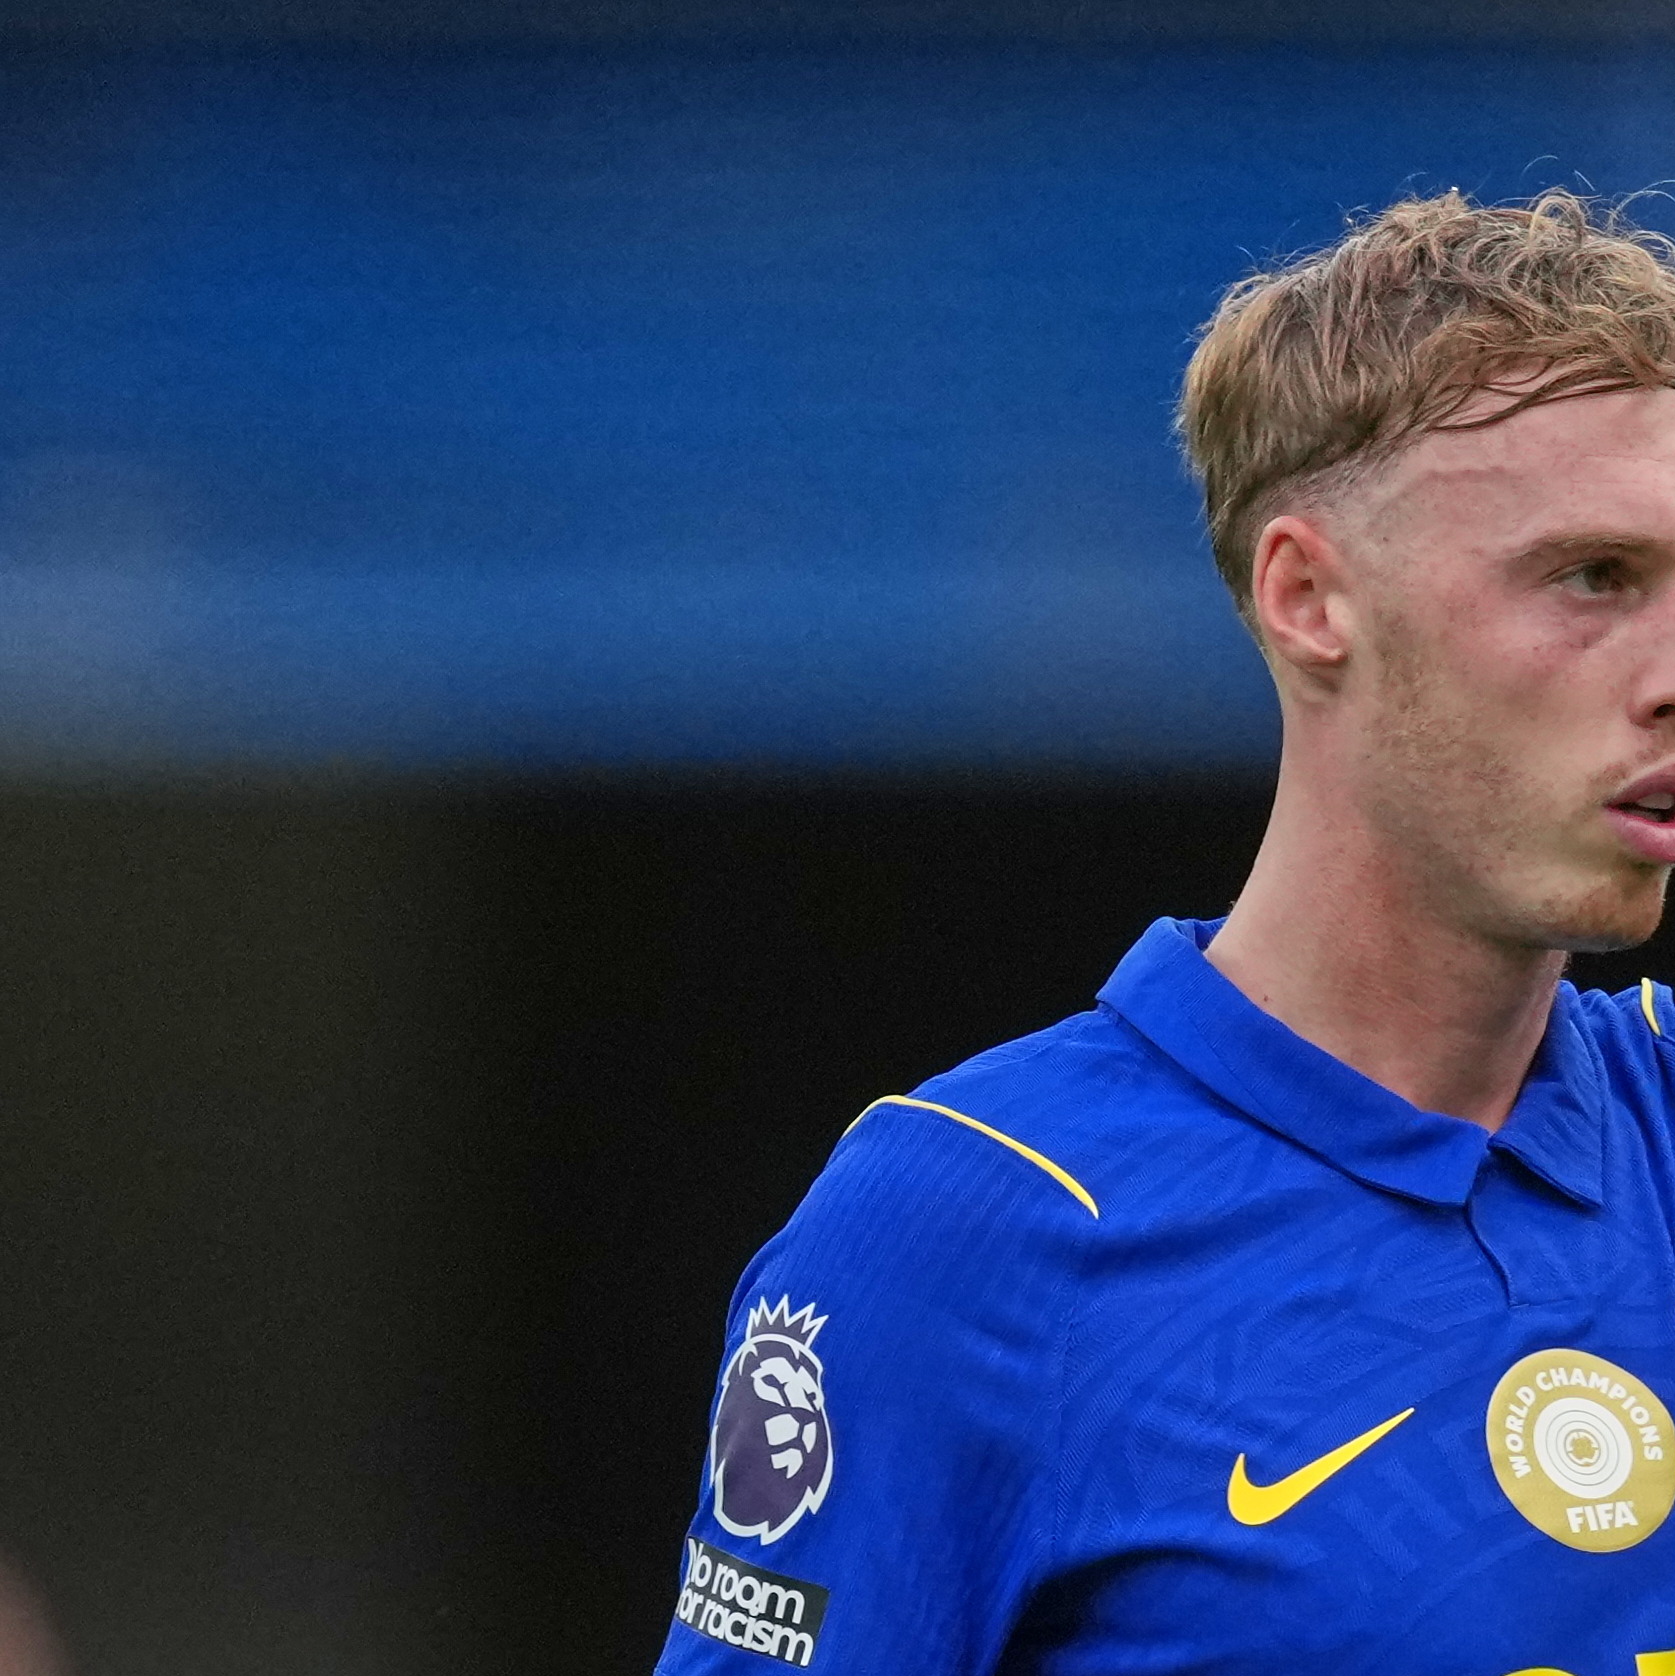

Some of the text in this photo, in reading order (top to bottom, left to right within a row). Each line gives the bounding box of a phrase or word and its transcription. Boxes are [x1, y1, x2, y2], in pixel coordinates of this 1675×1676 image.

[1504, 1367, 1664, 1479] WORLD CHAMPIONS
[1565, 1501, 1639, 1534] FIFA
[676, 1580, 815, 1667] or racism
[711, 1562, 806, 1625] room
